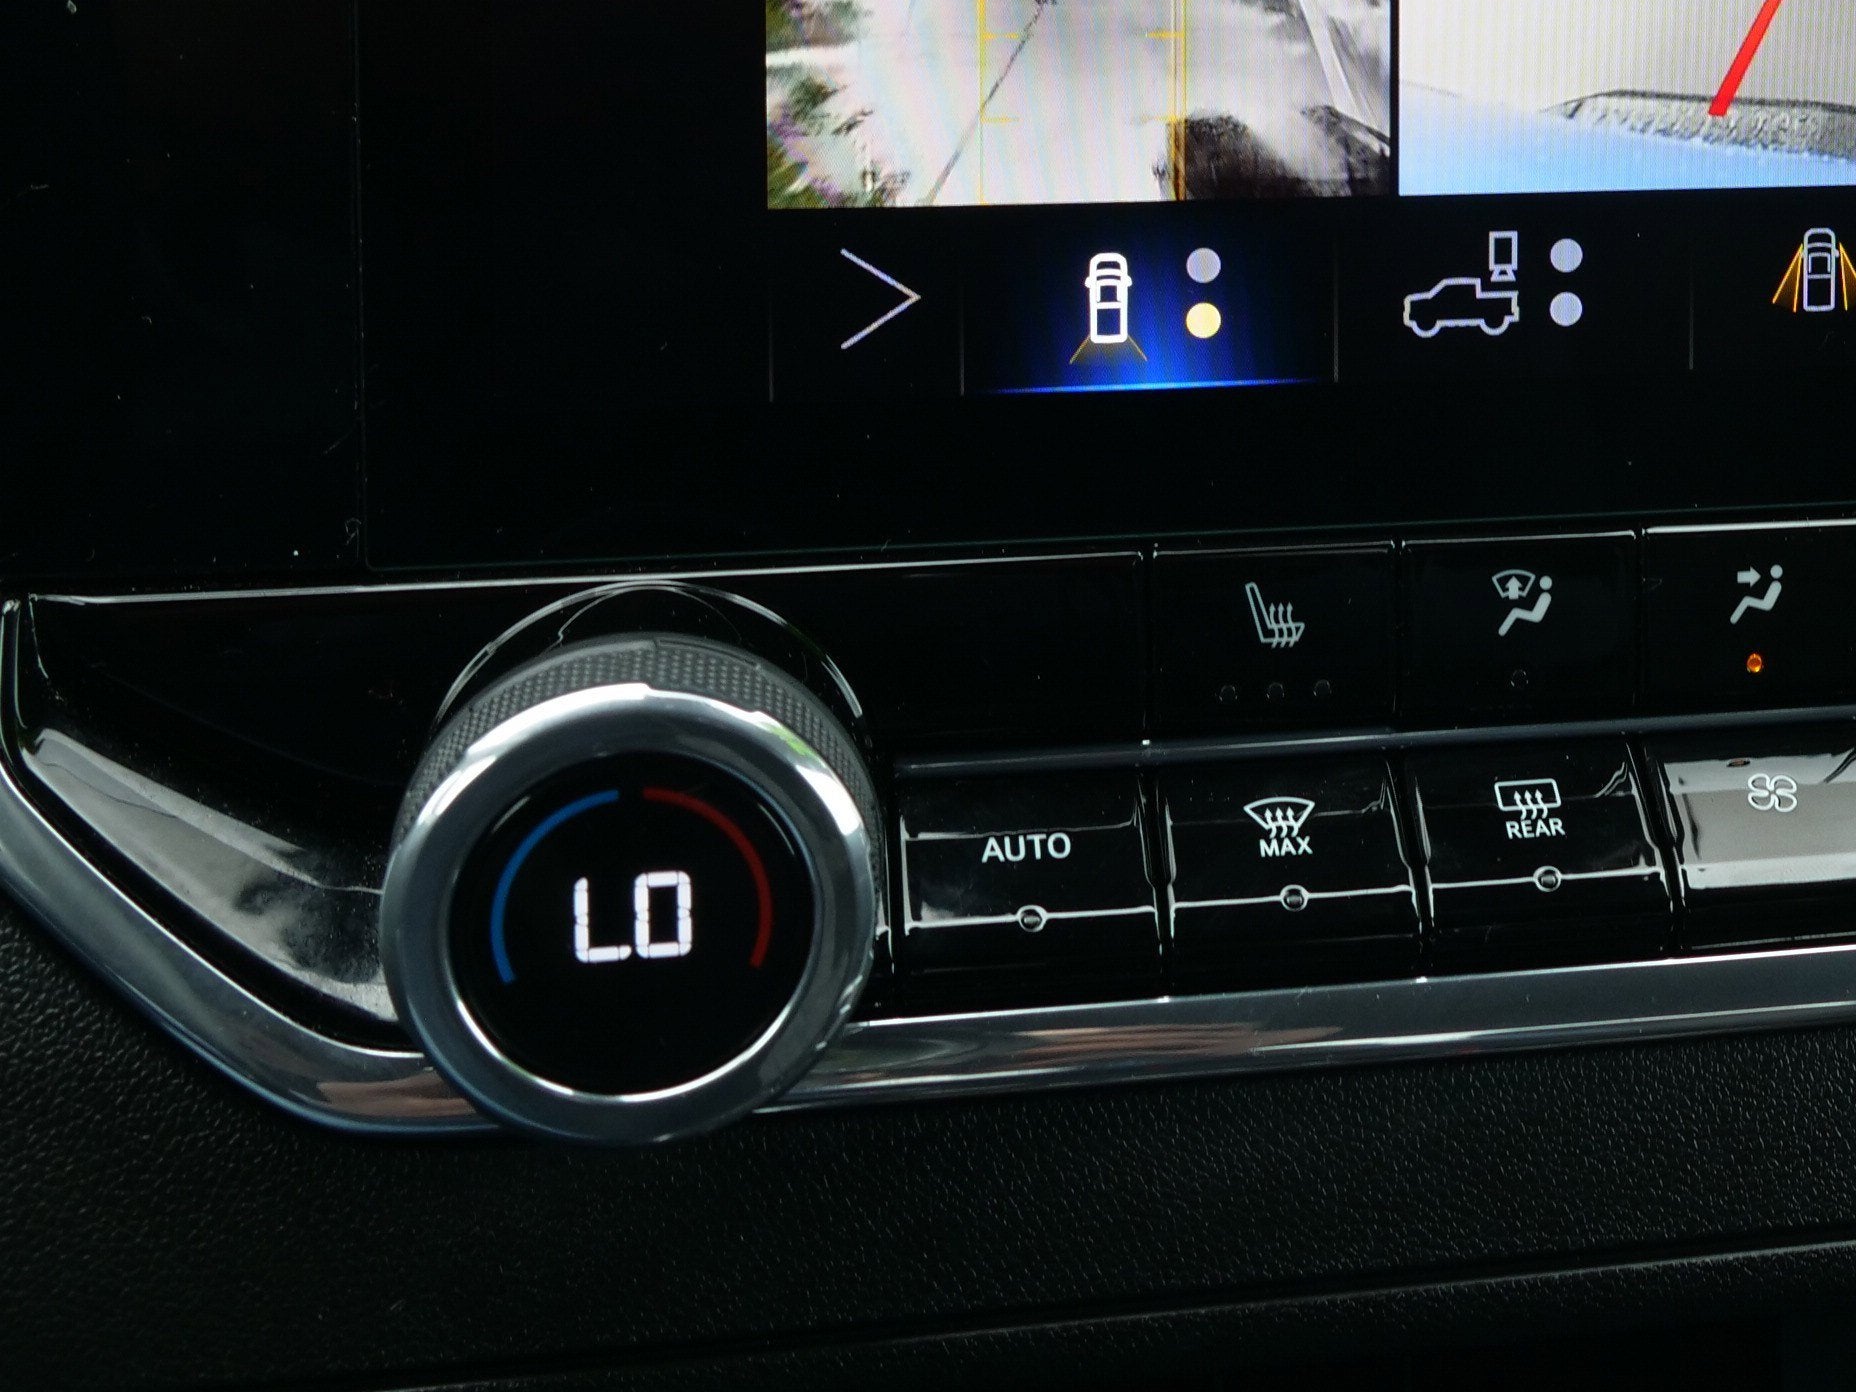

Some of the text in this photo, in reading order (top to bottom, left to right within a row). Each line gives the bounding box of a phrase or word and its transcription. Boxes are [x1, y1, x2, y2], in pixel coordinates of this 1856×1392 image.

[1505, 816, 1567, 840] REAR
[981, 831, 1072, 863] AUTO
[1259, 837, 1314, 858] MAX
[573, 870, 693, 963] LO
